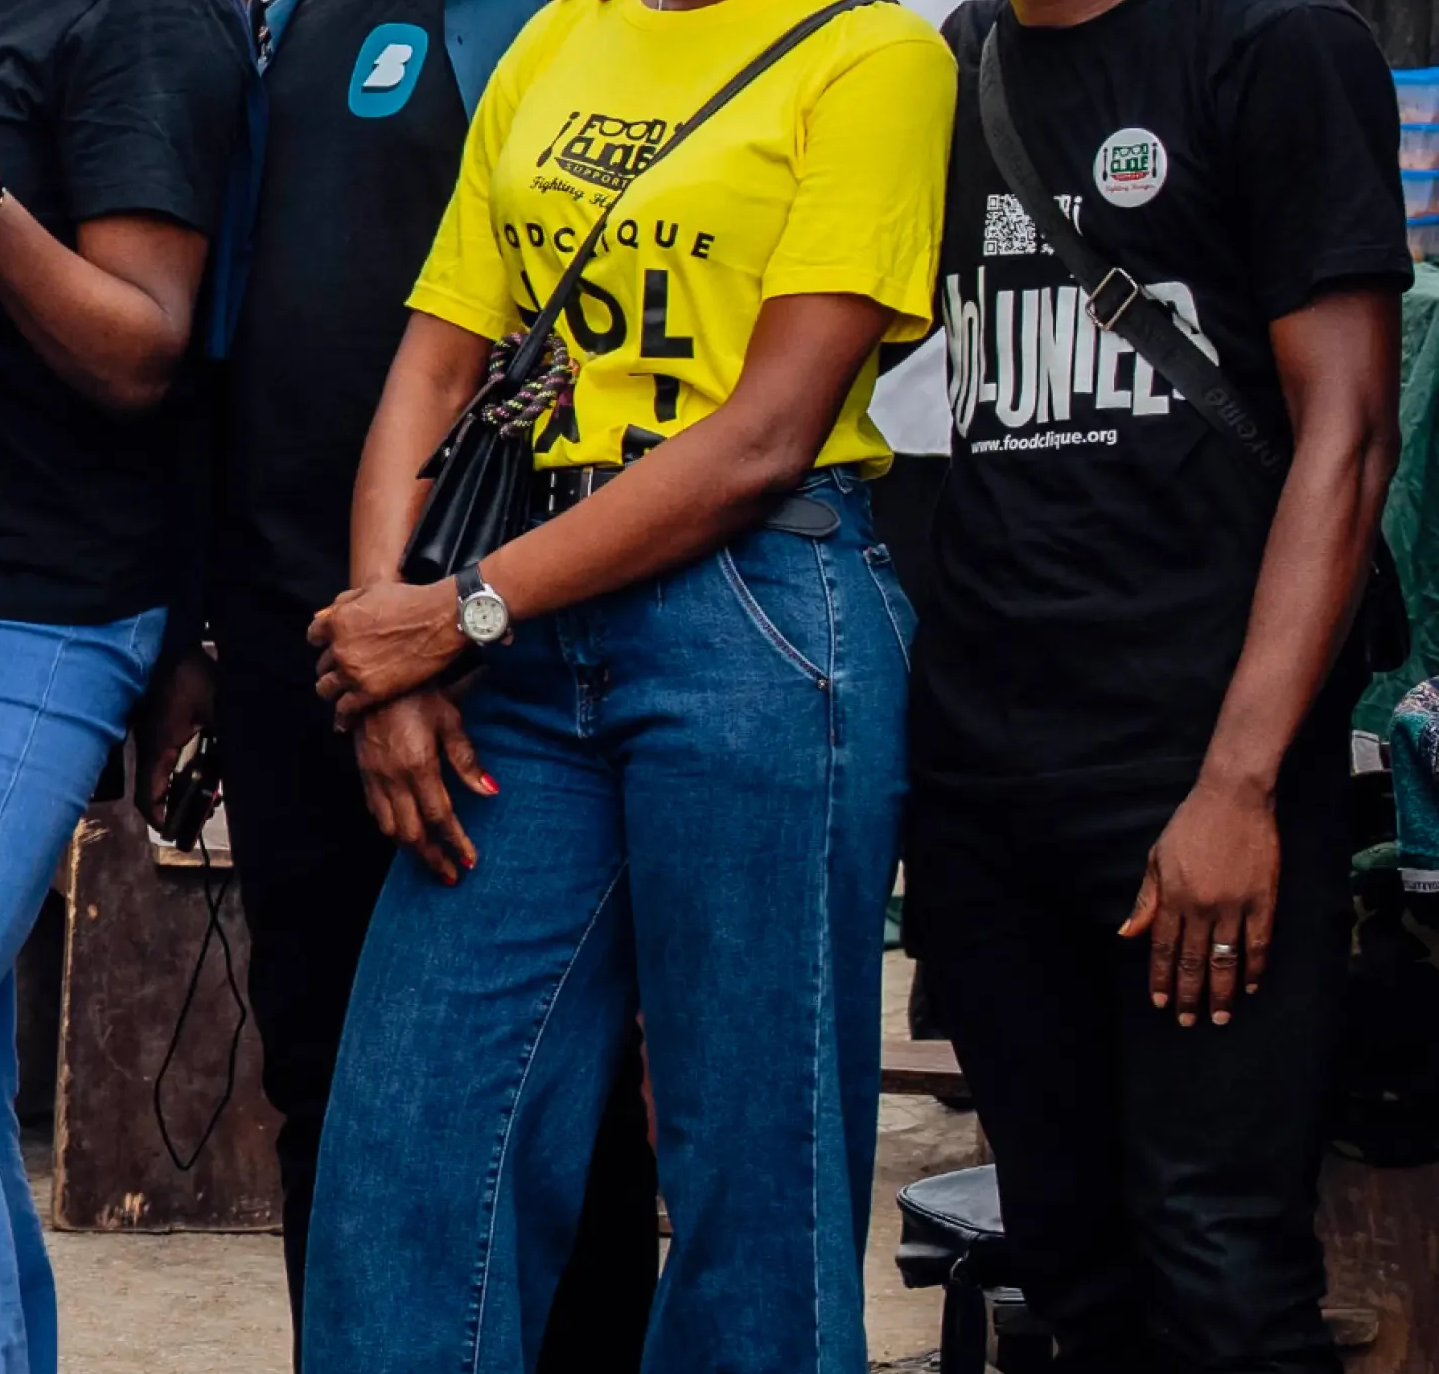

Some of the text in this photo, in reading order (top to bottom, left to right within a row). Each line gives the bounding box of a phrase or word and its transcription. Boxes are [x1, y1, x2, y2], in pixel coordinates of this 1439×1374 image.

[577, 113, 668, 145] FOOD
[529, 175, 585, 201] Fighting
[971, 428, 1118, 455] www.foodclique.org
